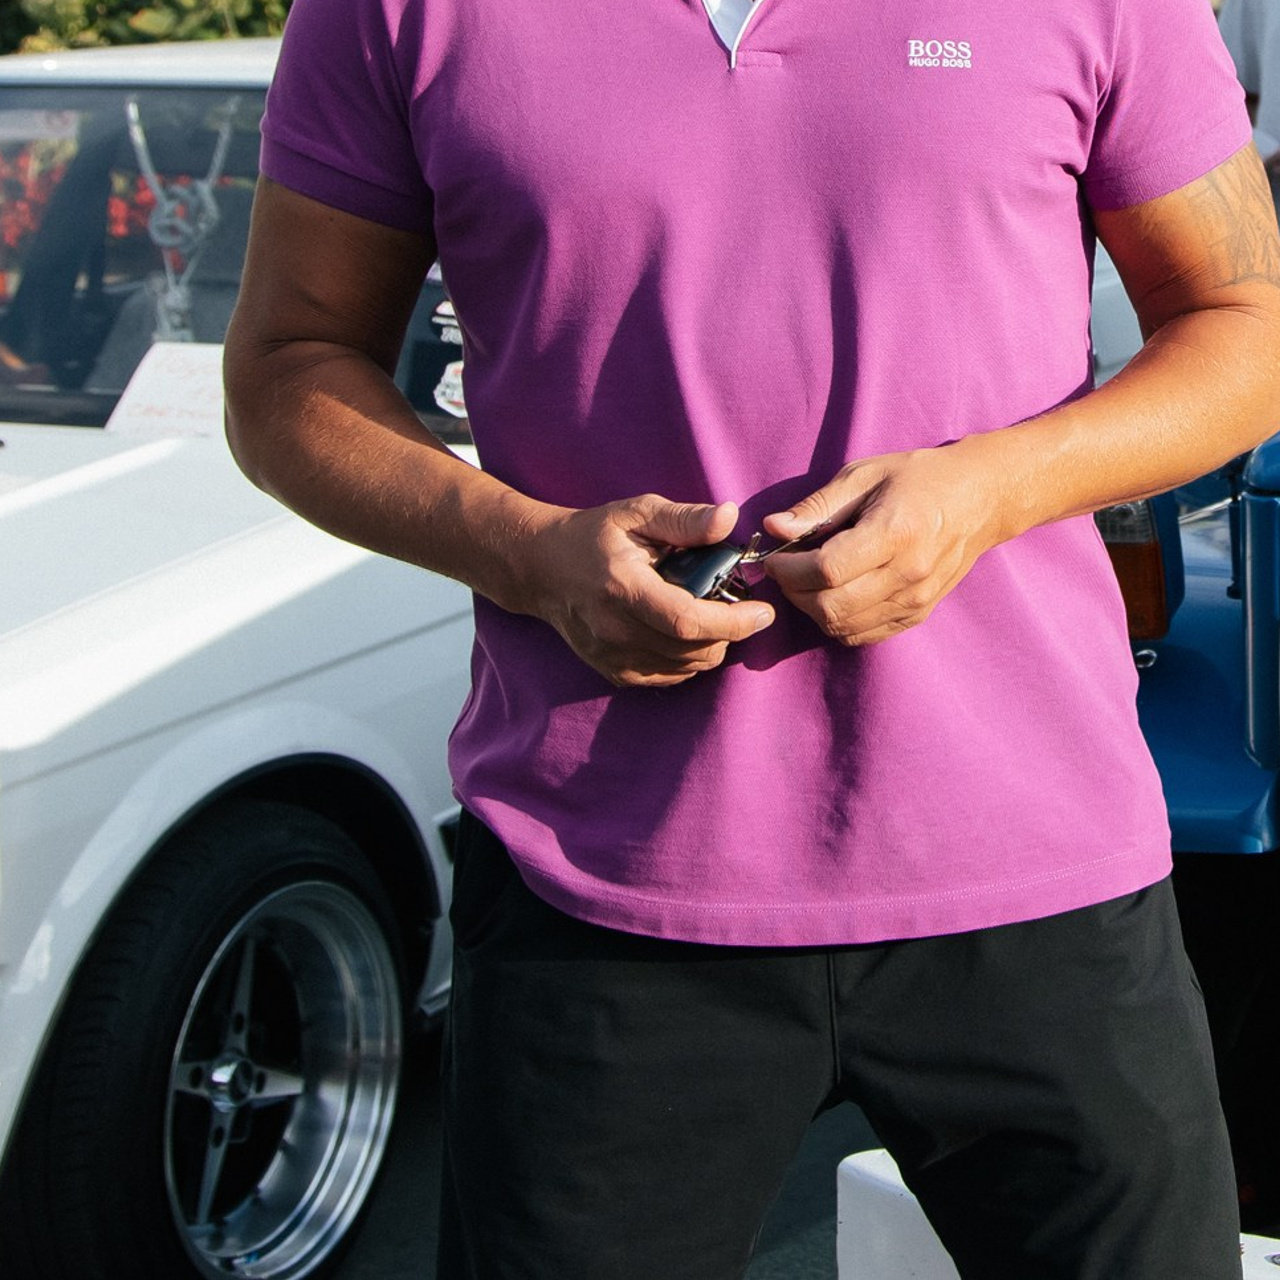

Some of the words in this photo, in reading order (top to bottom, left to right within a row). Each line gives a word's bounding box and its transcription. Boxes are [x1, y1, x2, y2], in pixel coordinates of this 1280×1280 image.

[908, 39, 972, 59] BOSS
[908, 57, 940, 67] HUGO
[942, 58, 972, 69] BOSS
